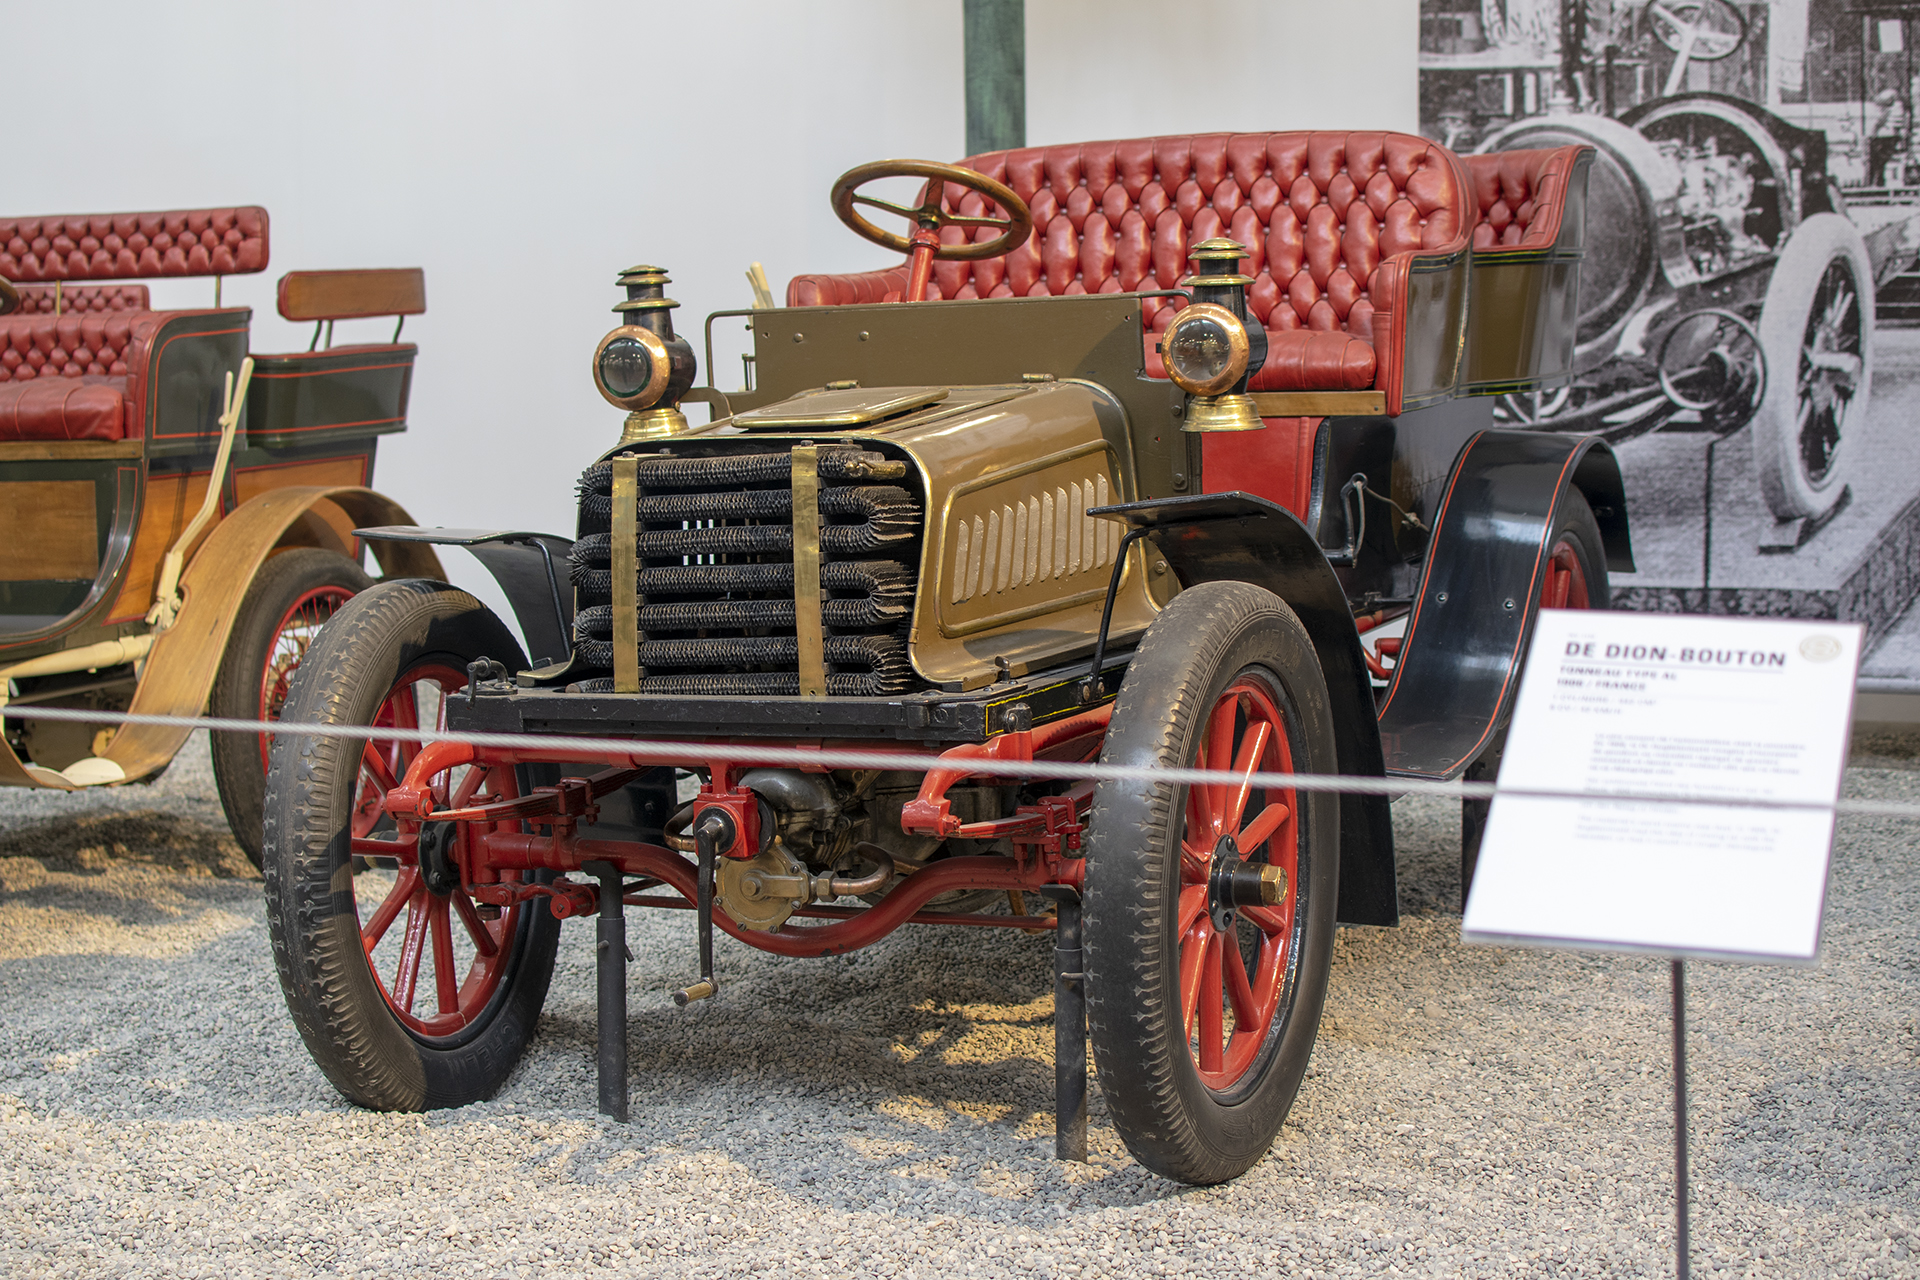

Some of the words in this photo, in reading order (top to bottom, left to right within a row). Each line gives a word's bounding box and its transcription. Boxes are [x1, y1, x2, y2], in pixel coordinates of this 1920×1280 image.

[1564, 641, 1595, 658] DE
[1605, 643, 1787, 667] DION-BOUTON
[1560, 665, 1621, 678] TONNEAU
[1626, 669, 1657, 679] TYPE
[1595, 680, 1646, 691] FRANCE
